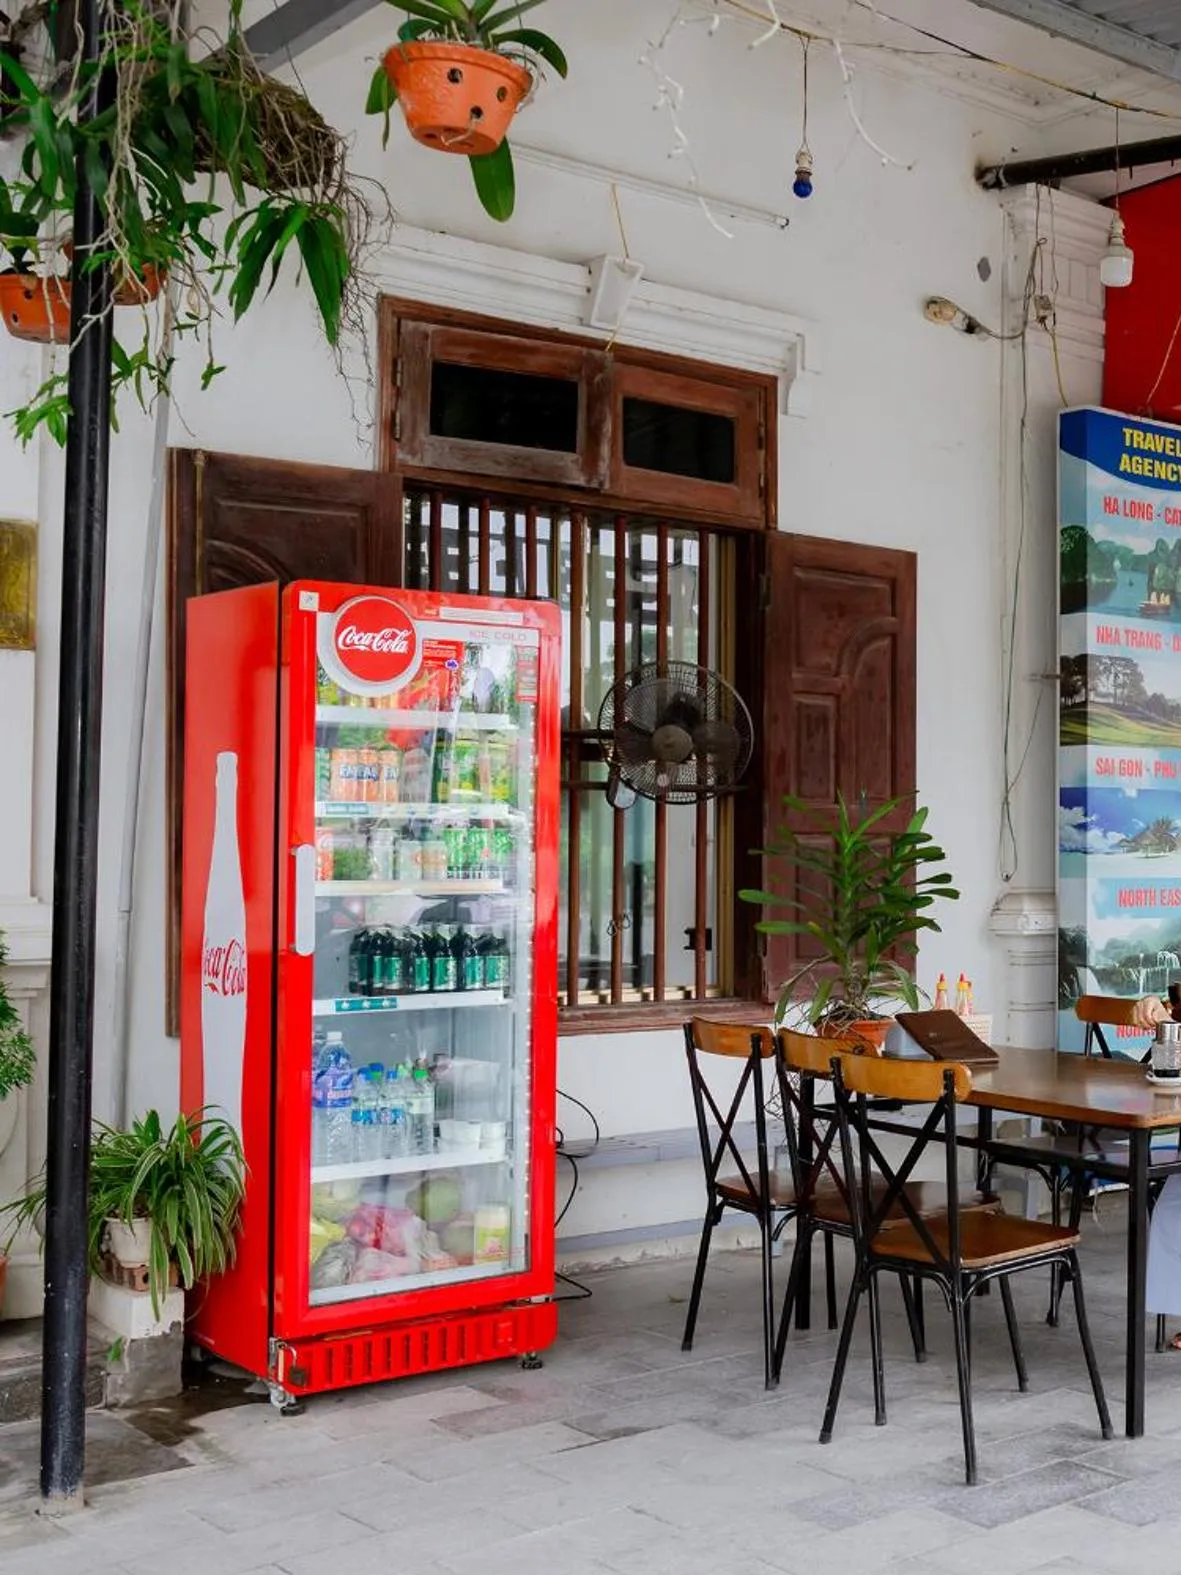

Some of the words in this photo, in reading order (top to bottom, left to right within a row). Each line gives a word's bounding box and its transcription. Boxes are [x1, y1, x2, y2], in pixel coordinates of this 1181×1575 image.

[1103, 496, 1120, 515] HA
[1123, 499, 1153, 521] LONG
[338, 625, 413, 653] Coca-Cola
[1096, 626, 1121, 646] NHA
[1124, 629, 1163, 650] TRANG
[1095, 756, 1115, 775] SAI
[1118, 759, 1143, 777] GON
[1117, 887, 1156, 908] NORTH
